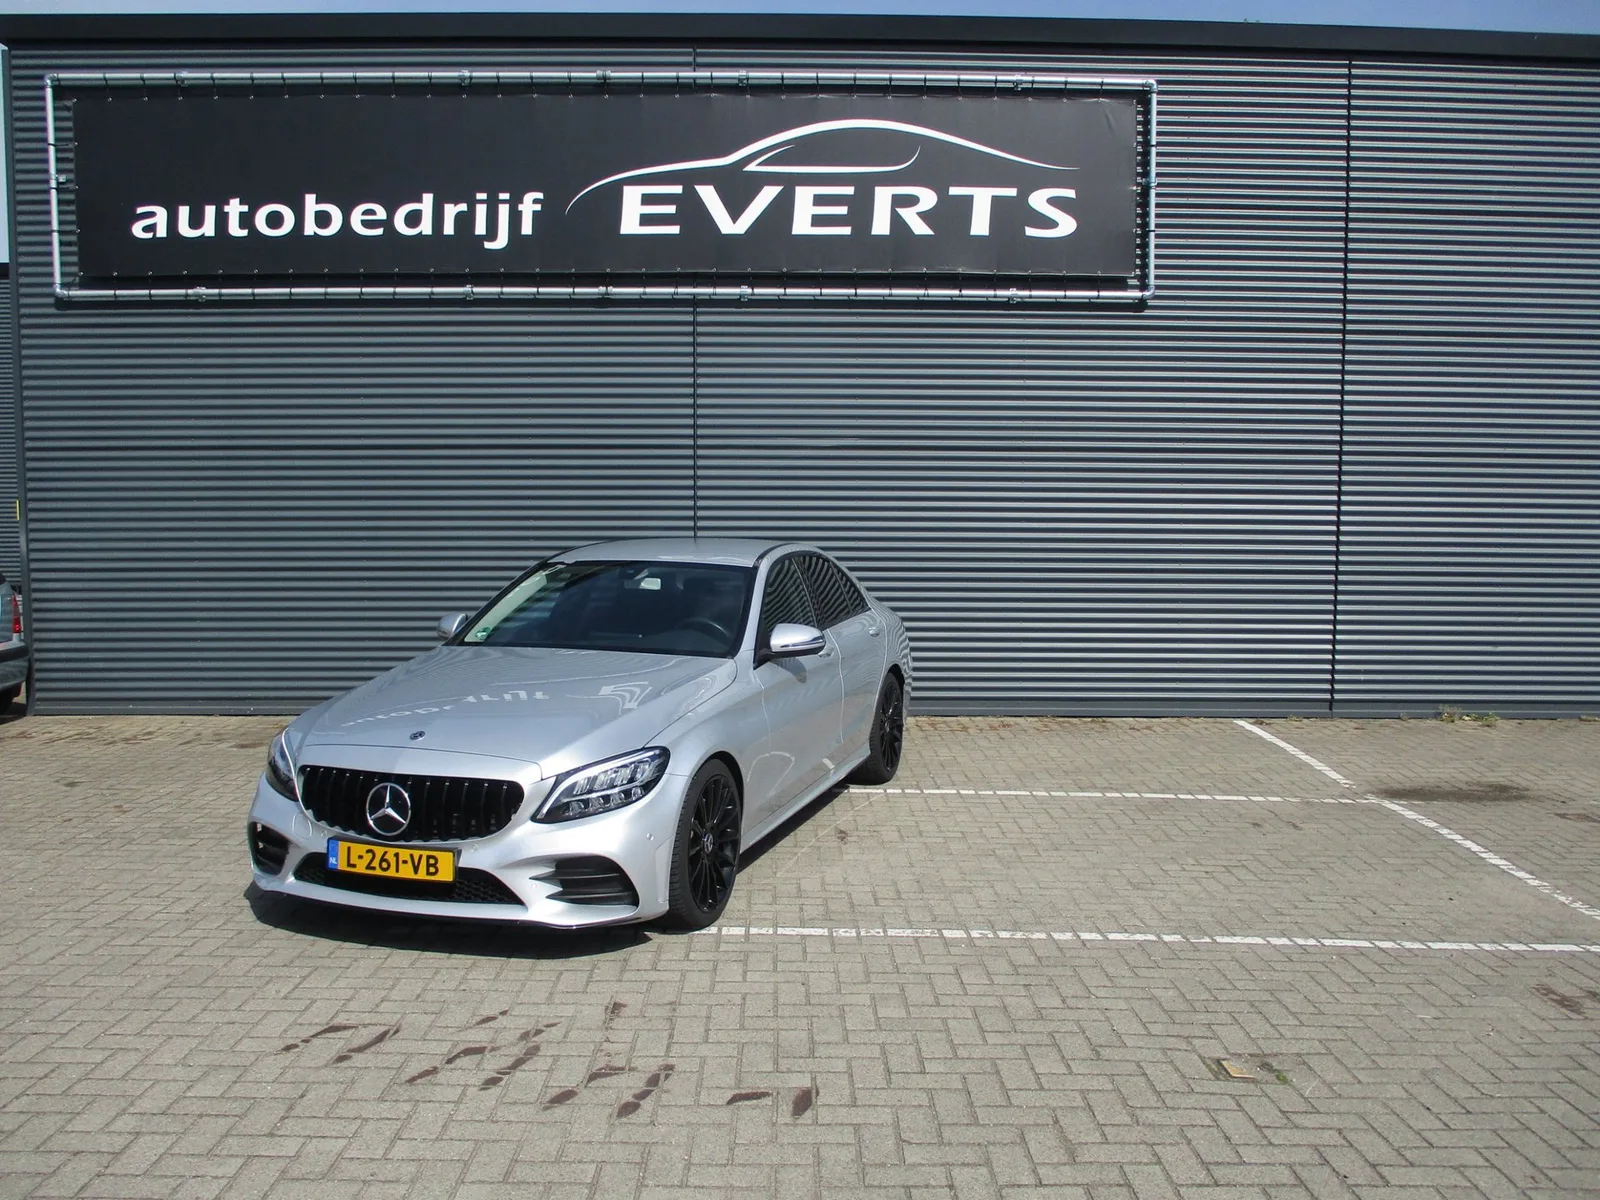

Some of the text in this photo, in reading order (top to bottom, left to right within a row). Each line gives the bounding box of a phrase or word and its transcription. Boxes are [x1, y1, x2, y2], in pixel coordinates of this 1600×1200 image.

[130, 184, 1078, 250] autobedrijf EVERTS
[329, 856, 338, 865] NL
[346, 846, 440, 877] L-261-VB
